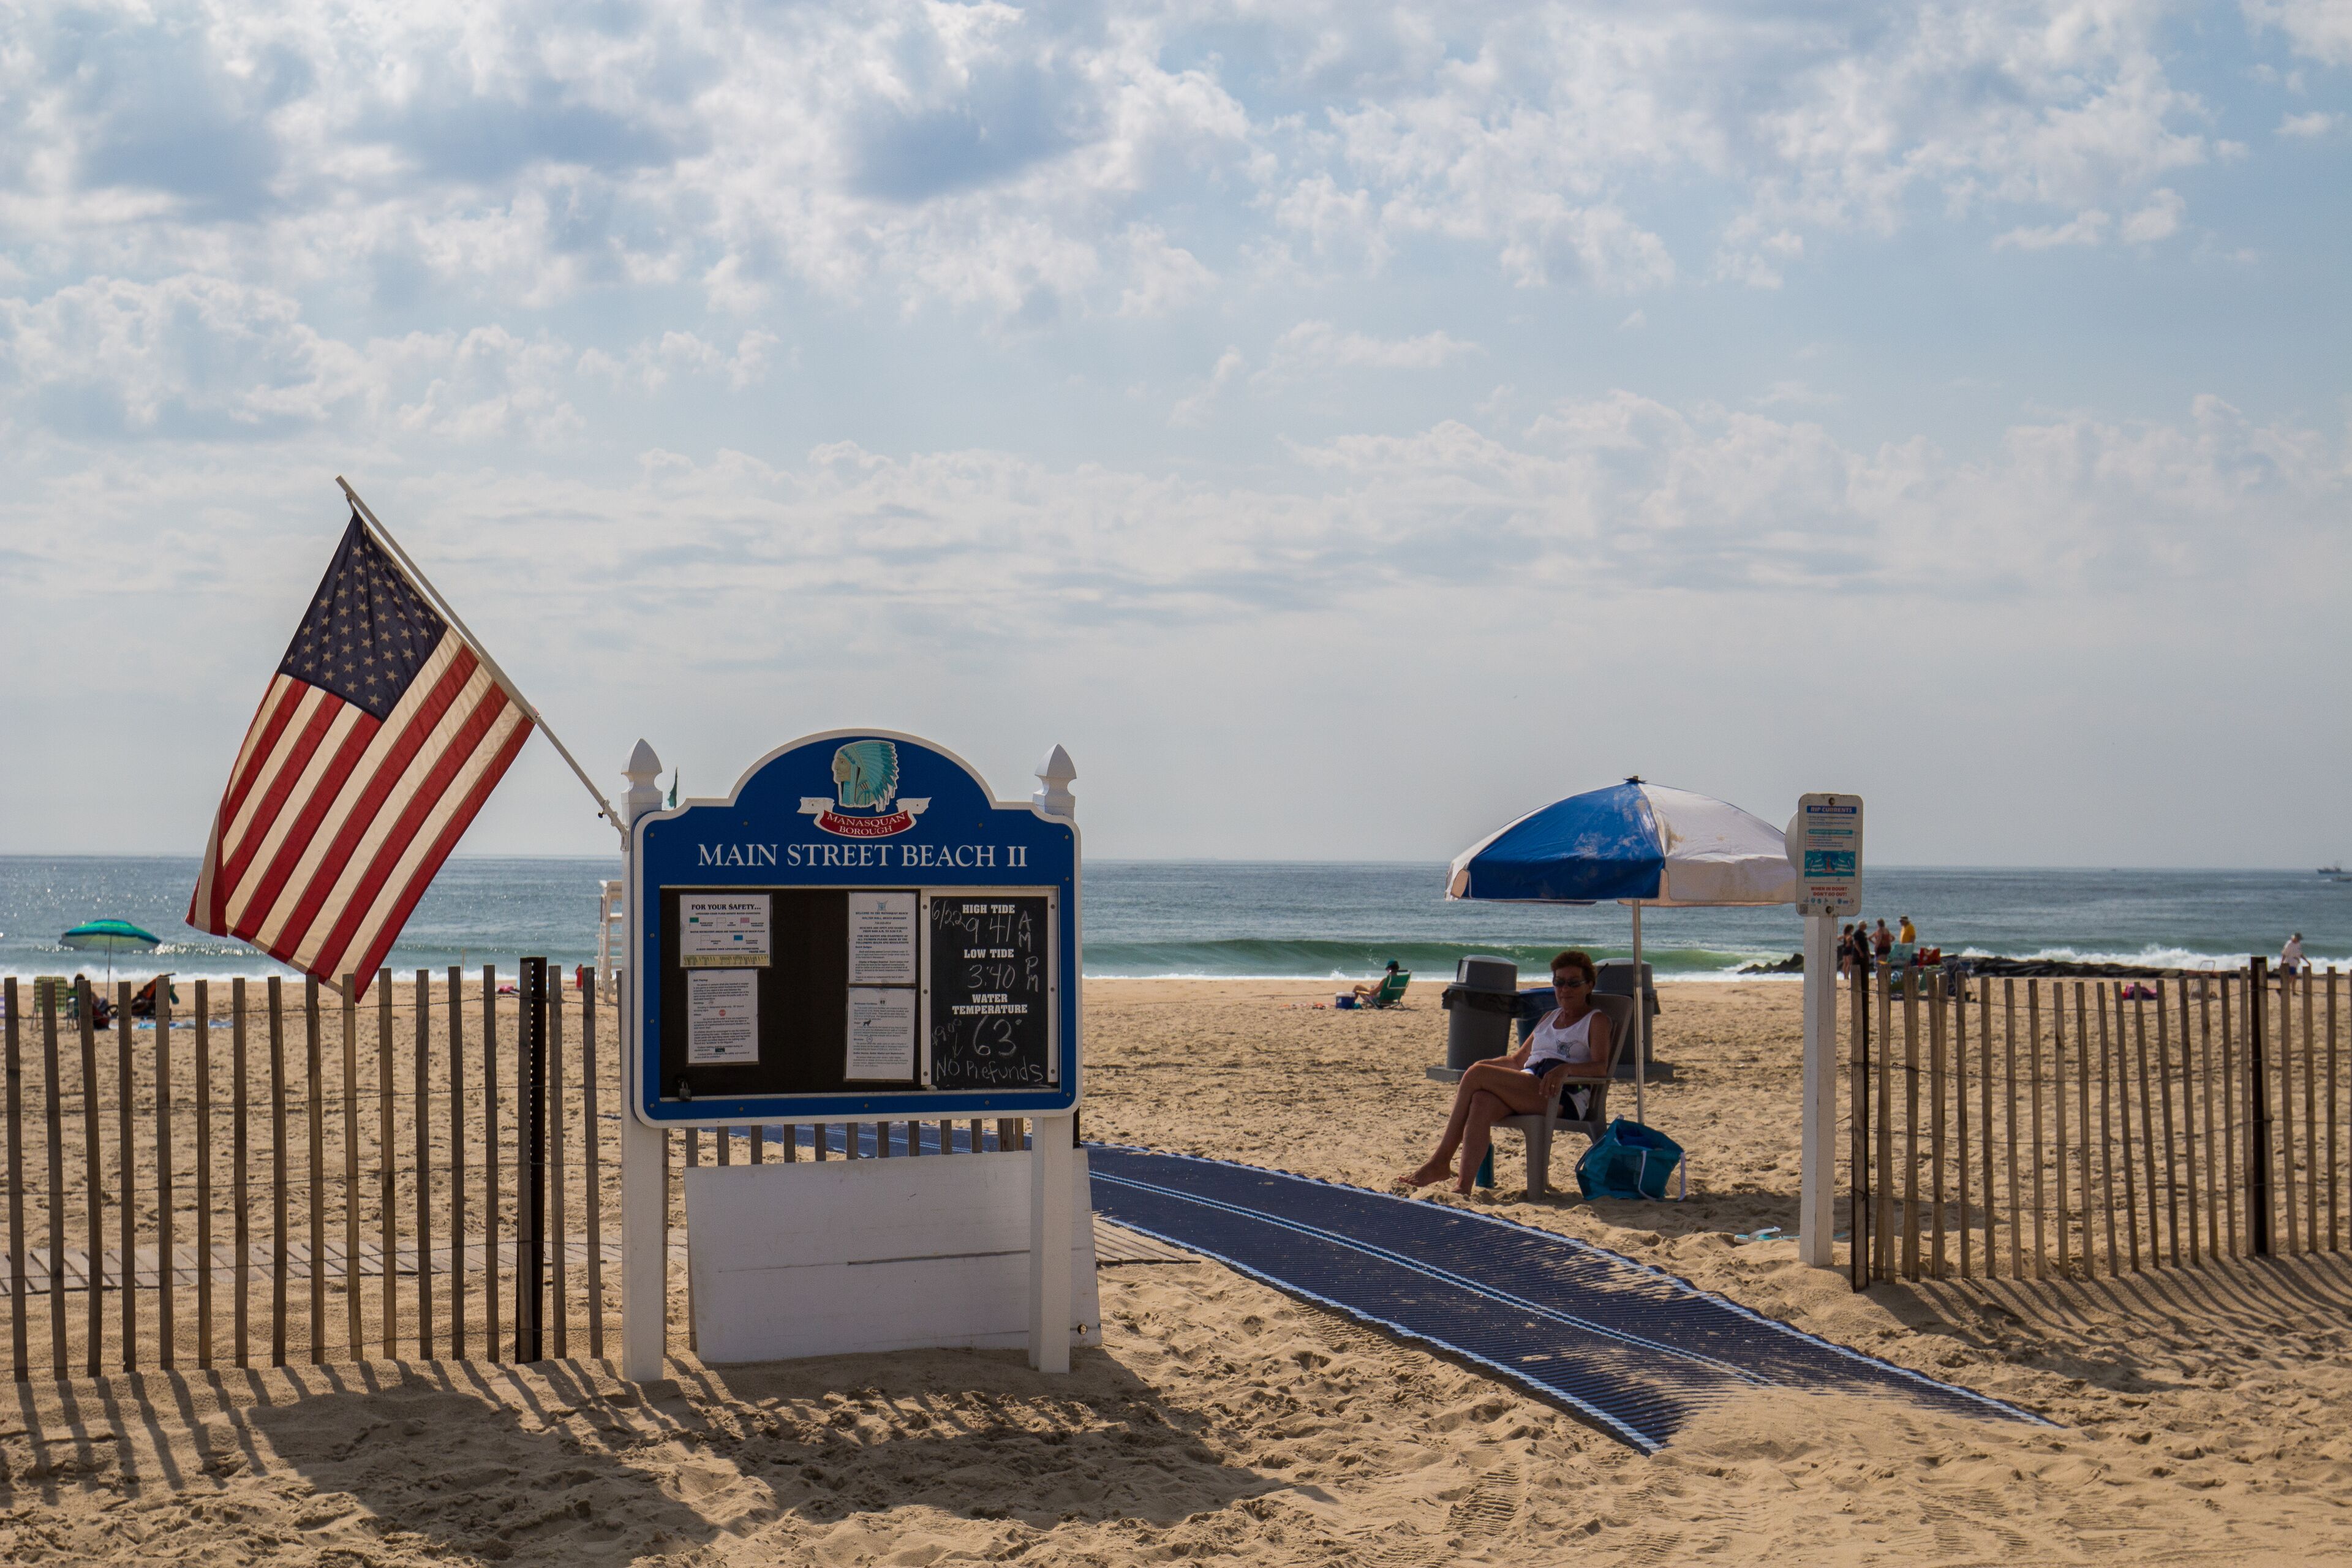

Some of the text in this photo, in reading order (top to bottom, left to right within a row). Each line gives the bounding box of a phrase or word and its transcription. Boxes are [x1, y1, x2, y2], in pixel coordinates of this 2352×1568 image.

[827, 813, 905, 827] MANASQUAN
[839, 826, 892, 835] BOROUGH
[698, 844, 1028, 867] MAIN STREET BEACH II
[932, 900, 967, 930] 6/22
[962, 904, 1015, 914] HIGH TIDE
[964, 949, 1014, 958] LOW TIDE
[967, 963, 1016, 989] 3:40
[972, 993, 1008, 1003] WATER
[952, 1004, 1028, 1014] TEMPERATURE
[967, 1055, 1044, 1083] Refunds
